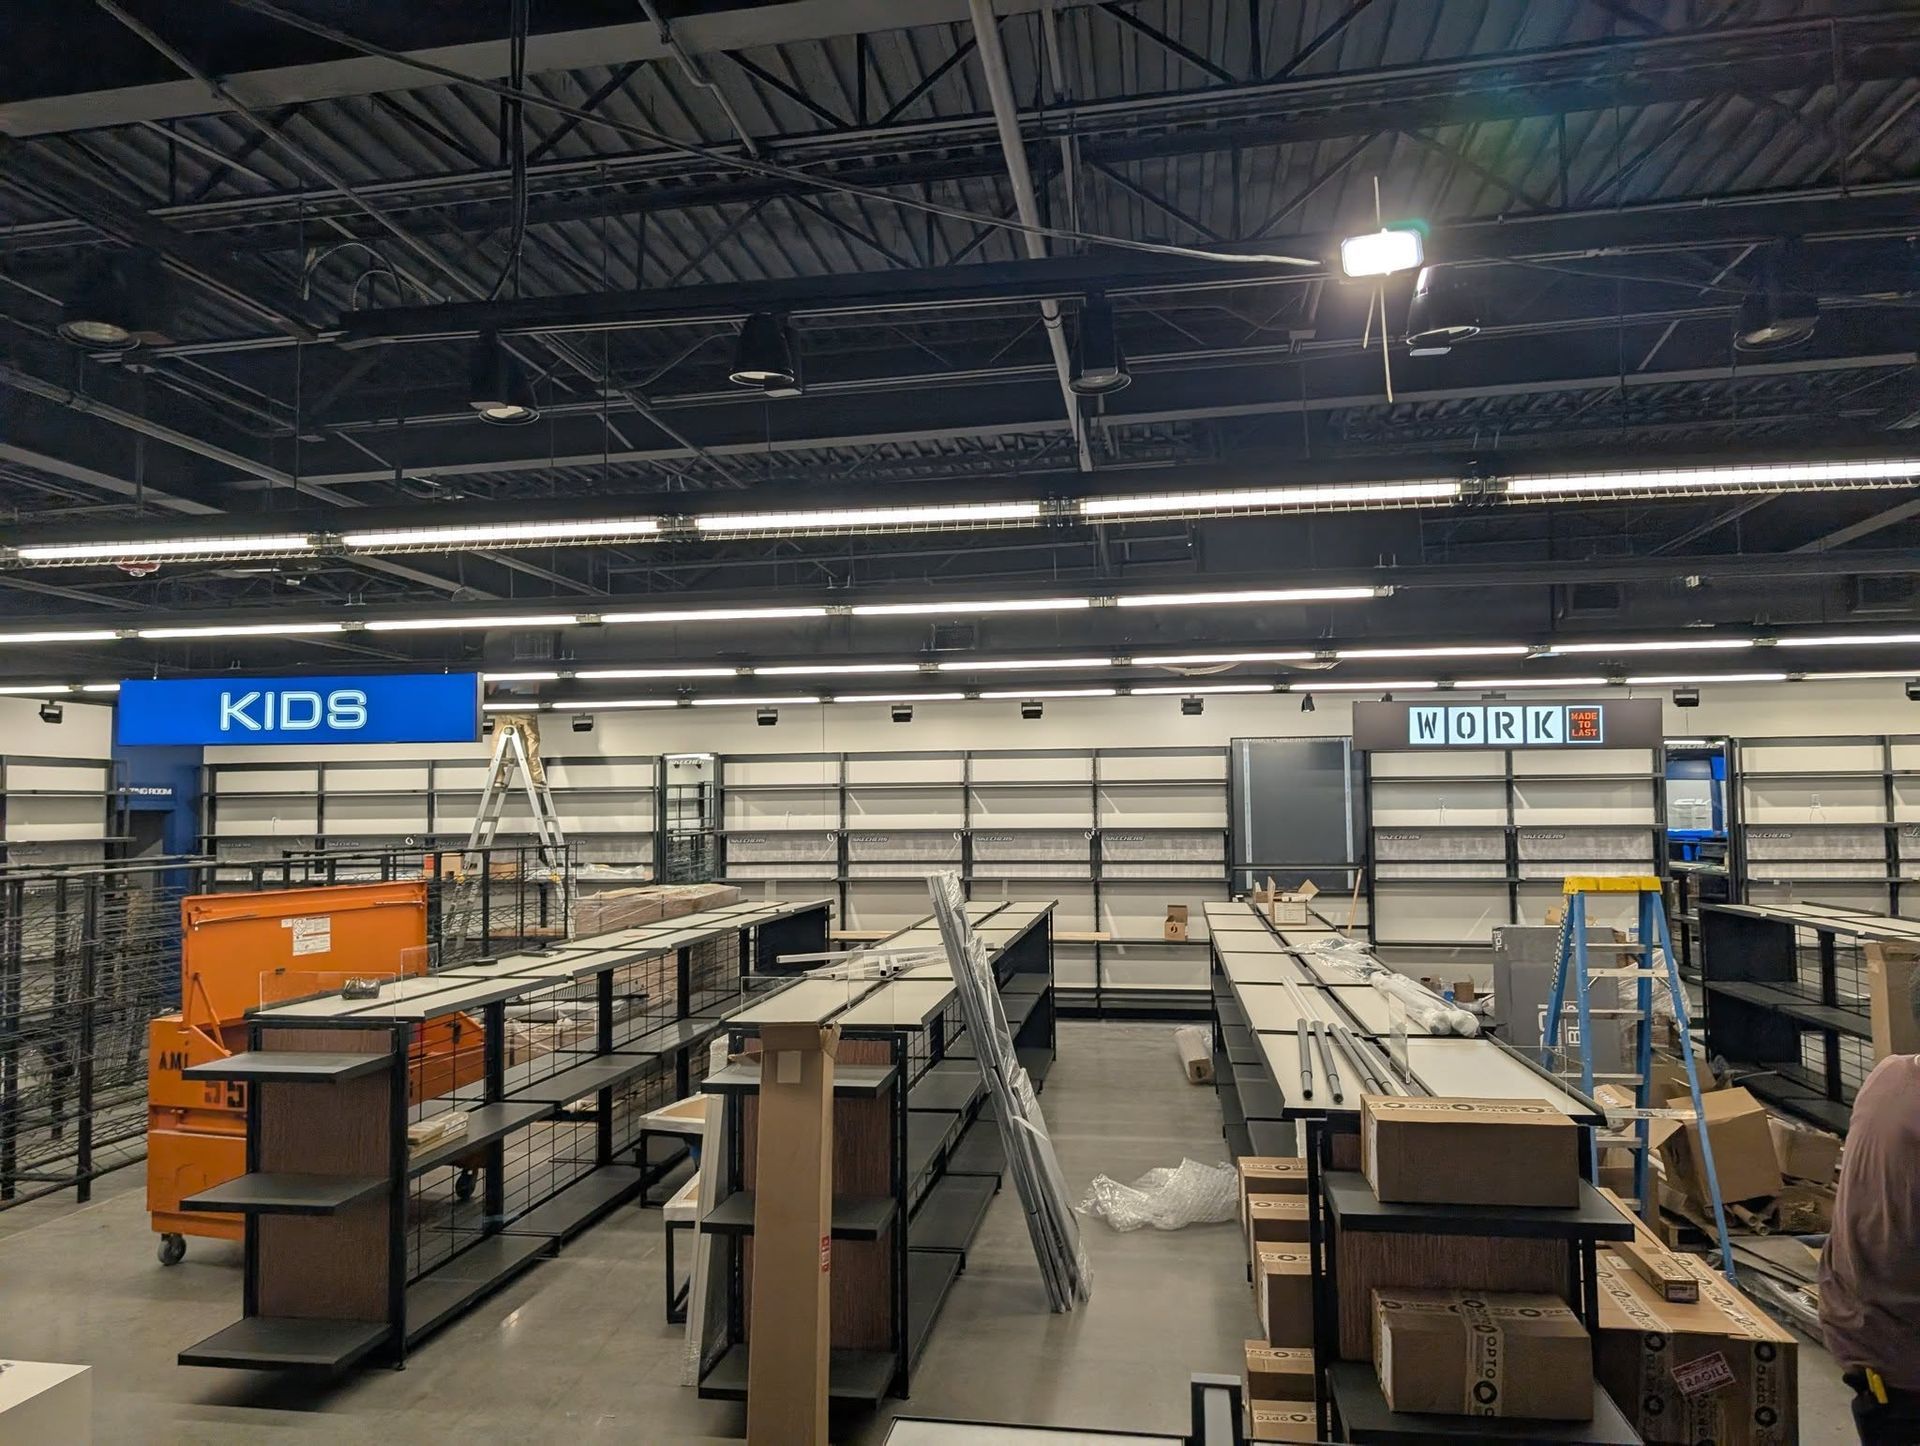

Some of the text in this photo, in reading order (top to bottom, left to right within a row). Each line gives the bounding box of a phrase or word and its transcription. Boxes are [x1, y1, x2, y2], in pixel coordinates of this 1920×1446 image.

[220, 689, 367, 731] KIDS
[1571, 712, 1597, 720] MADE
[1417, 711, 1553, 739] WORK
[1485, 1336, 1497, 1379] OPTO
[1679, 1362, 1729, 1391] FRAGILE
